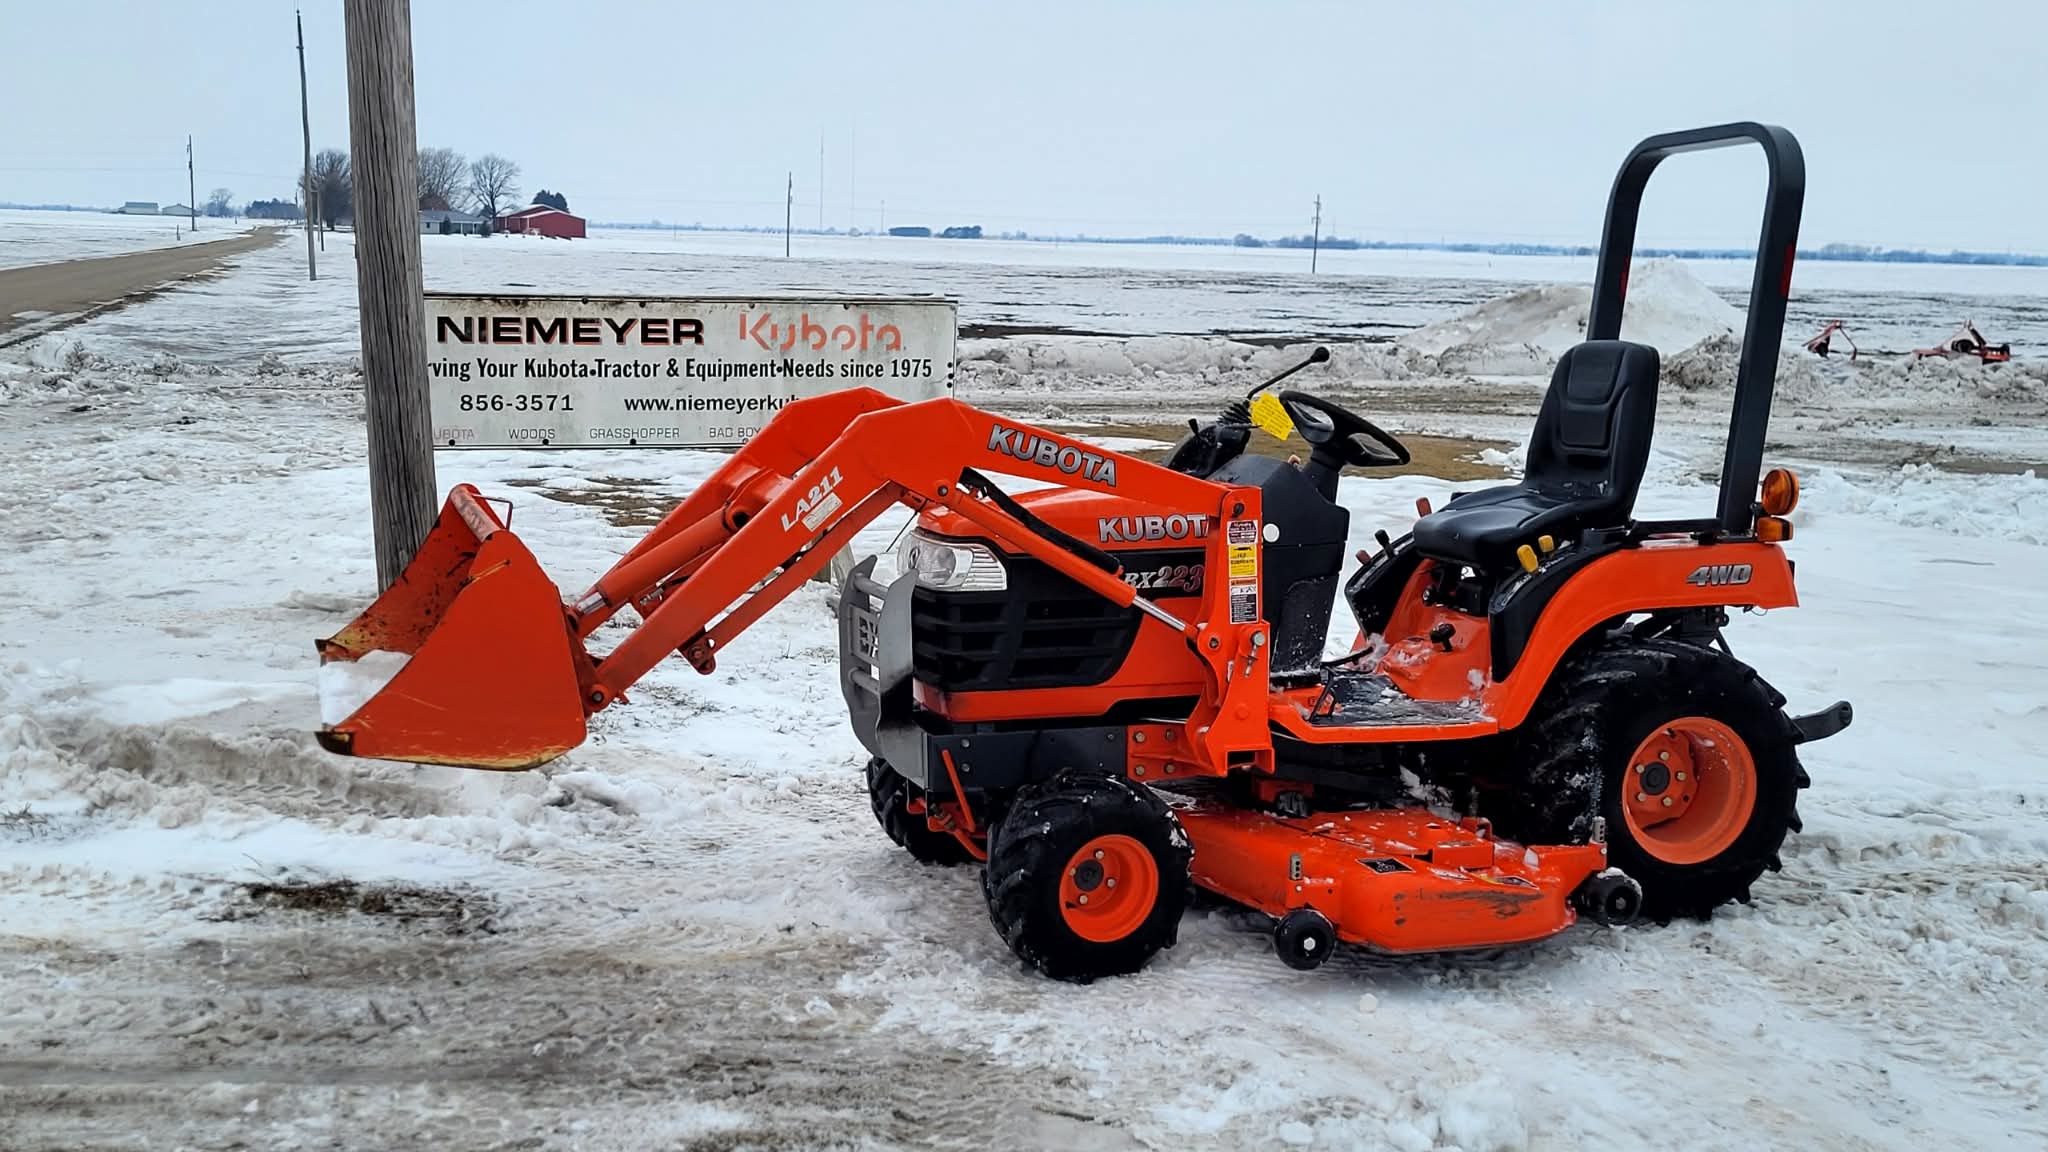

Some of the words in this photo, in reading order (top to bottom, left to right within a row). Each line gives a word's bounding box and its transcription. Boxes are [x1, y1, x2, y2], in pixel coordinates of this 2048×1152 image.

[437, 316, 705, 345] NIEMEYER
[739, 313, 902, 351] Kubota
[476, 357, 518, 378] Your
[524, 358, 588, 378] Kubota
[594, 358, 660, 378] Tractor
[666, 358, 679, 378] &
[686, 358, 776, 382] Equipment
[783, 358, 834, 378] Needs
[840, 359, 884, 378] since
[891, 359, 932, 378] 1975
[460, 394, 574, 411] 856-3571
[508, 428, 556, 439] WOODS
[589, 427, 680, 439] GRASSHOPPER
[987, 424, 1117, 488] KUBOTA
[781, 465, 843, 532] LA211
[1098, 513, 1209, 542] KUBOT
[1685, 563, 1753, 587] 4WD
